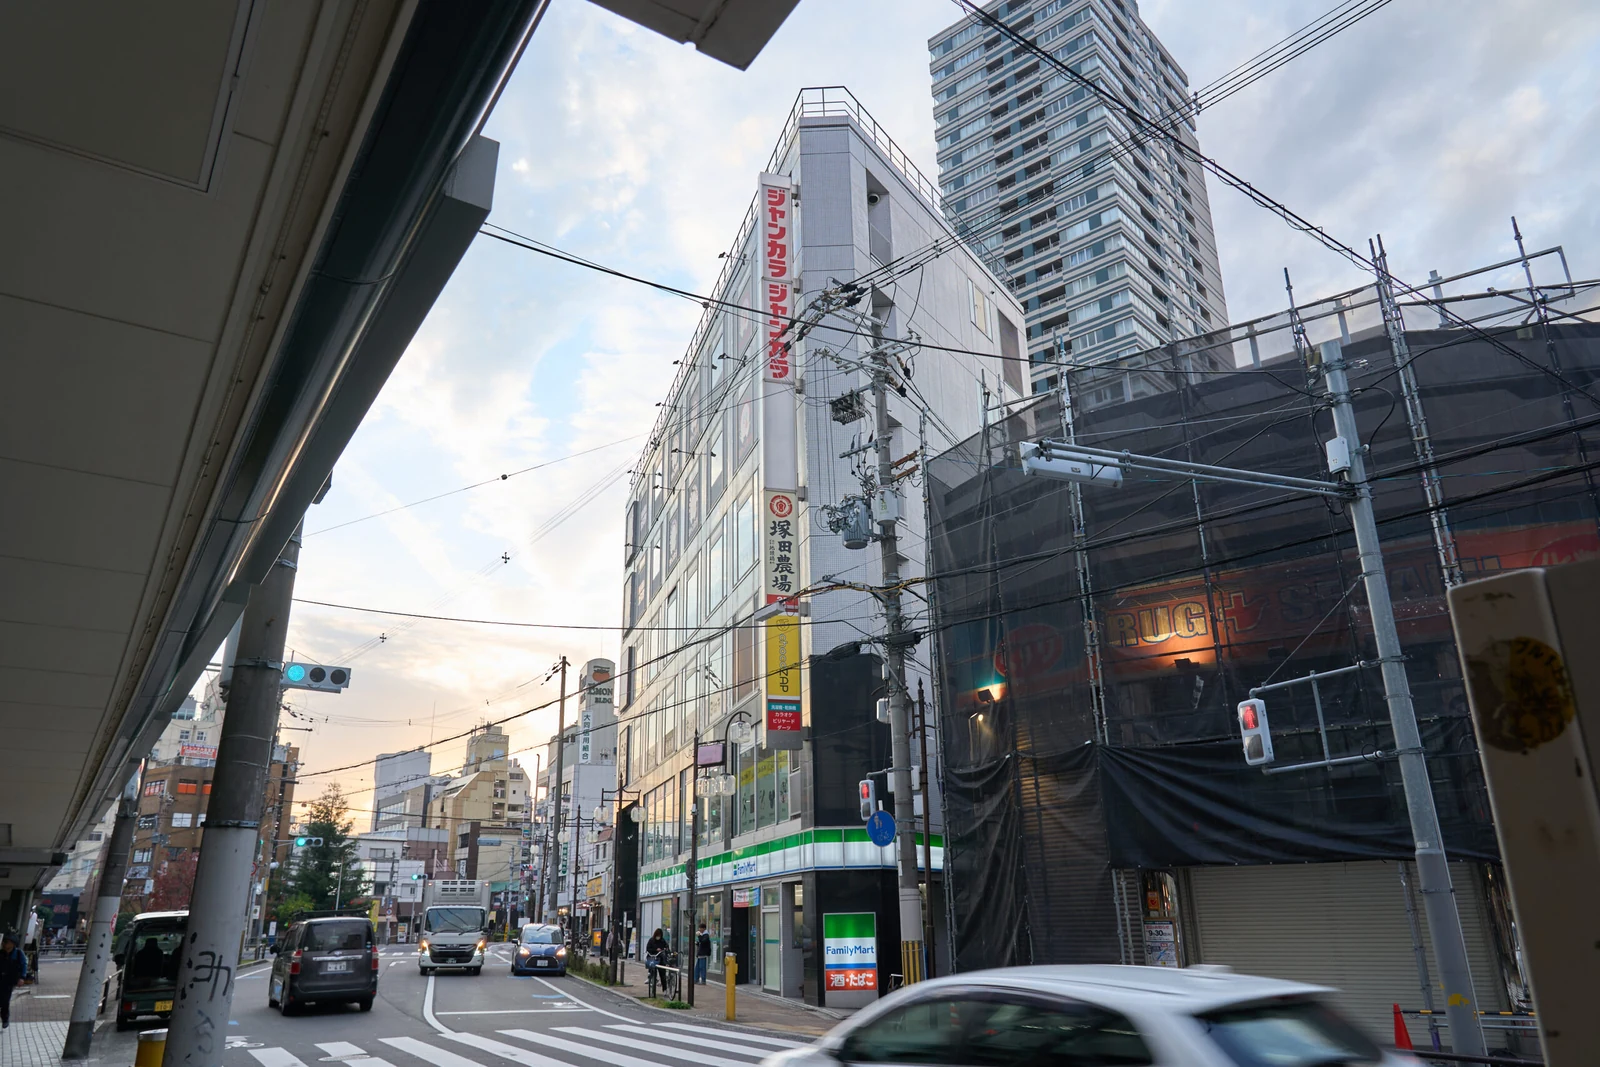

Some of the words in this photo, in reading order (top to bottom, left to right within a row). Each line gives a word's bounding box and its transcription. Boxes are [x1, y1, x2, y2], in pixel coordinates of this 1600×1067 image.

[767, 189, 787, 277] ジャンカラ
[769, 520, 795, 593] 塚田農場
[826, 945, 875, 956] FamilyMart
[830, 973, 874, 987] 酒・たばこ
